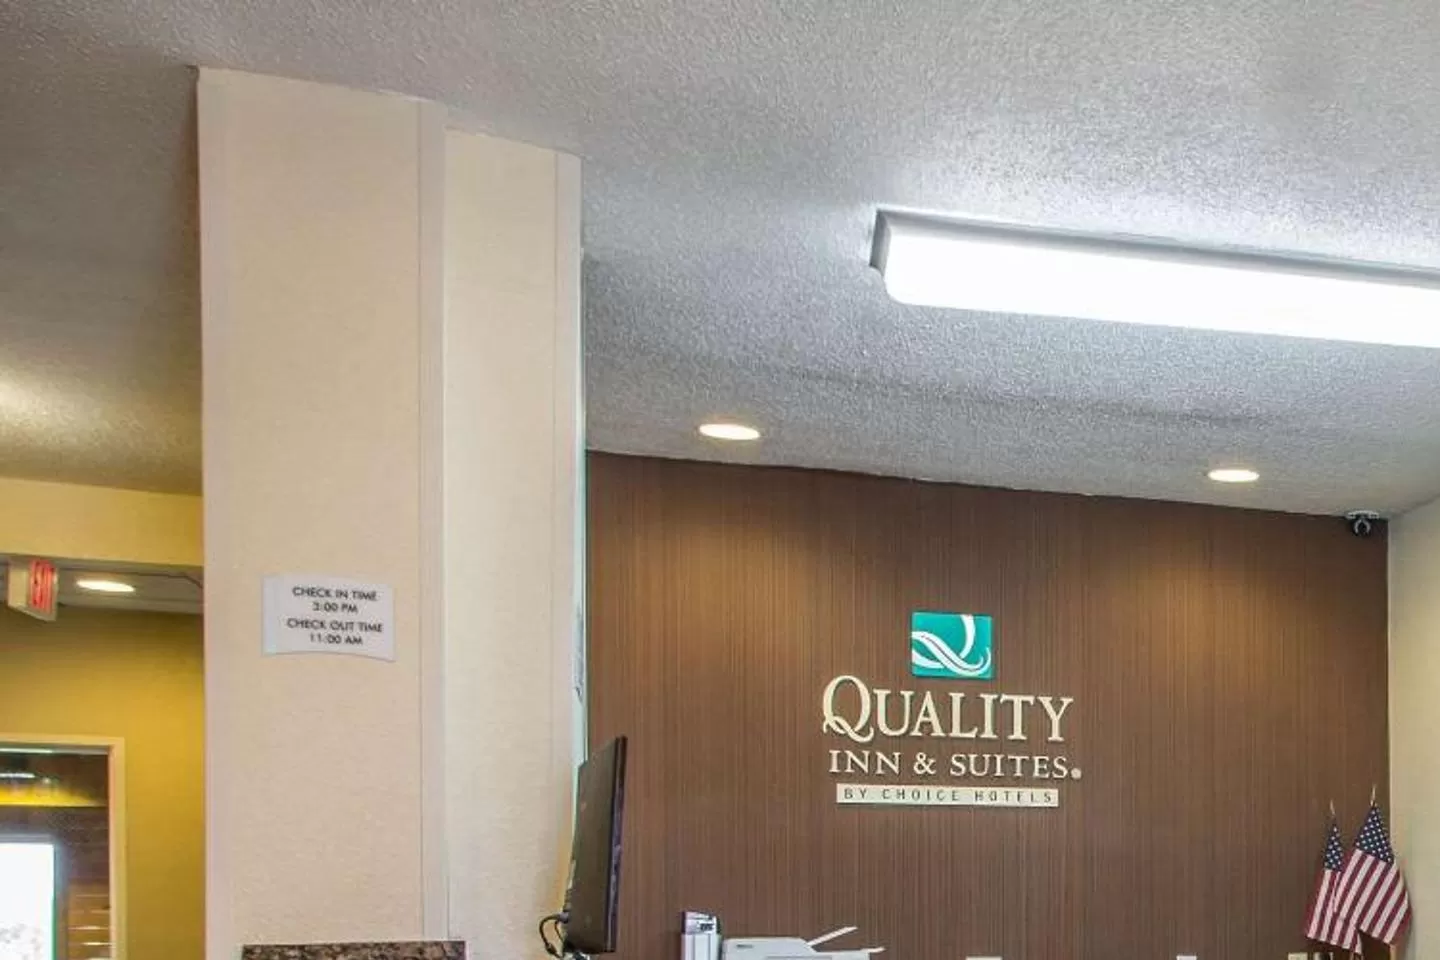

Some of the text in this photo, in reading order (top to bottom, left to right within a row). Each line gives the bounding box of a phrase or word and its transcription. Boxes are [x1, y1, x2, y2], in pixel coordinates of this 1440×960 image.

[292, 586, 378, 601] CHECK IN TIME
[312, 601, 358, 614] 3:00 PM
[286, 618, 383, 633] CHECK OUT TIME
[310, 633, 363, 645] 11:00 AM
[822, 674, 1074, 743] QUALITY
[828, 750, 900, 775] INN
[913, 752, 937, 776] &
[844, 788, 1052, 803] BY CHOICE HOTELS
